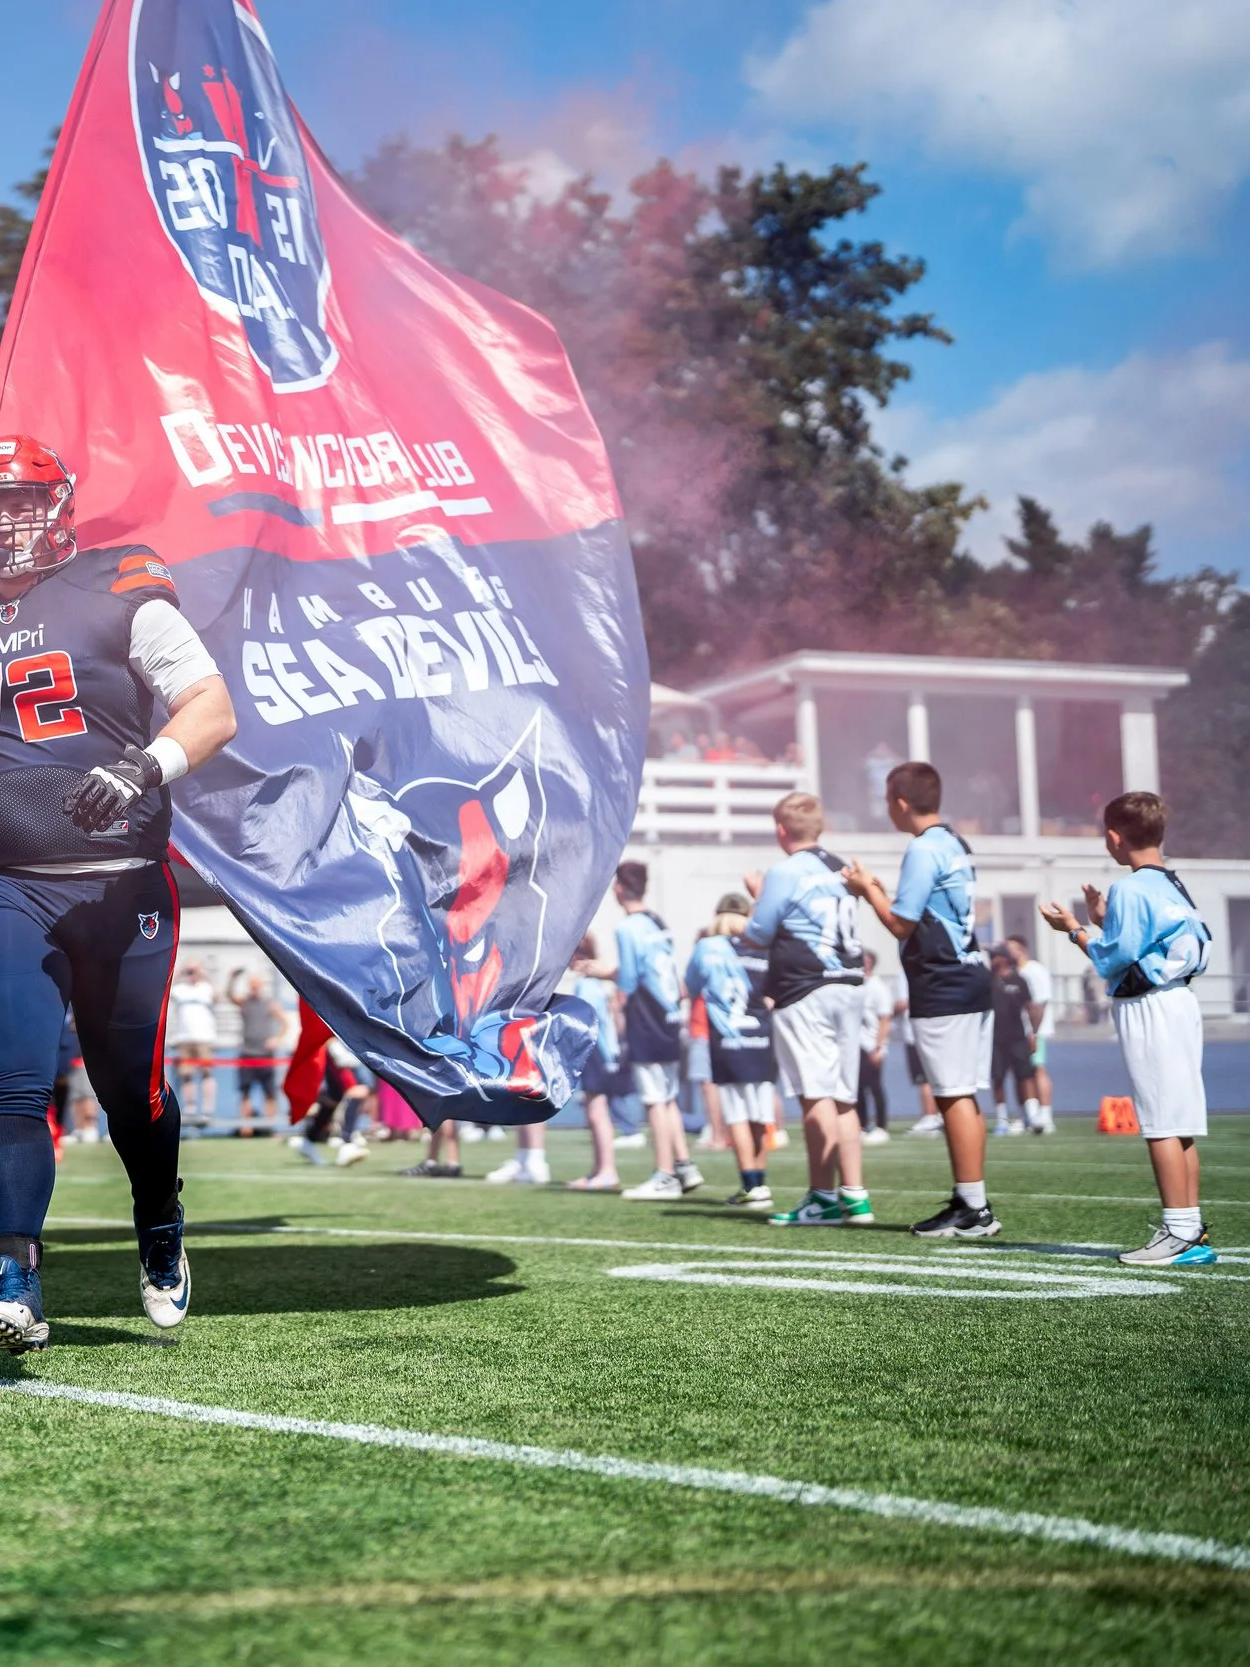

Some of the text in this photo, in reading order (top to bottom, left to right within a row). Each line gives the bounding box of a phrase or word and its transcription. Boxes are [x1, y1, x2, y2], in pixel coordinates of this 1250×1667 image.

[158, 157, 307, 265] 20 21
[242, 610, 559, 726] SEA DEVILS
